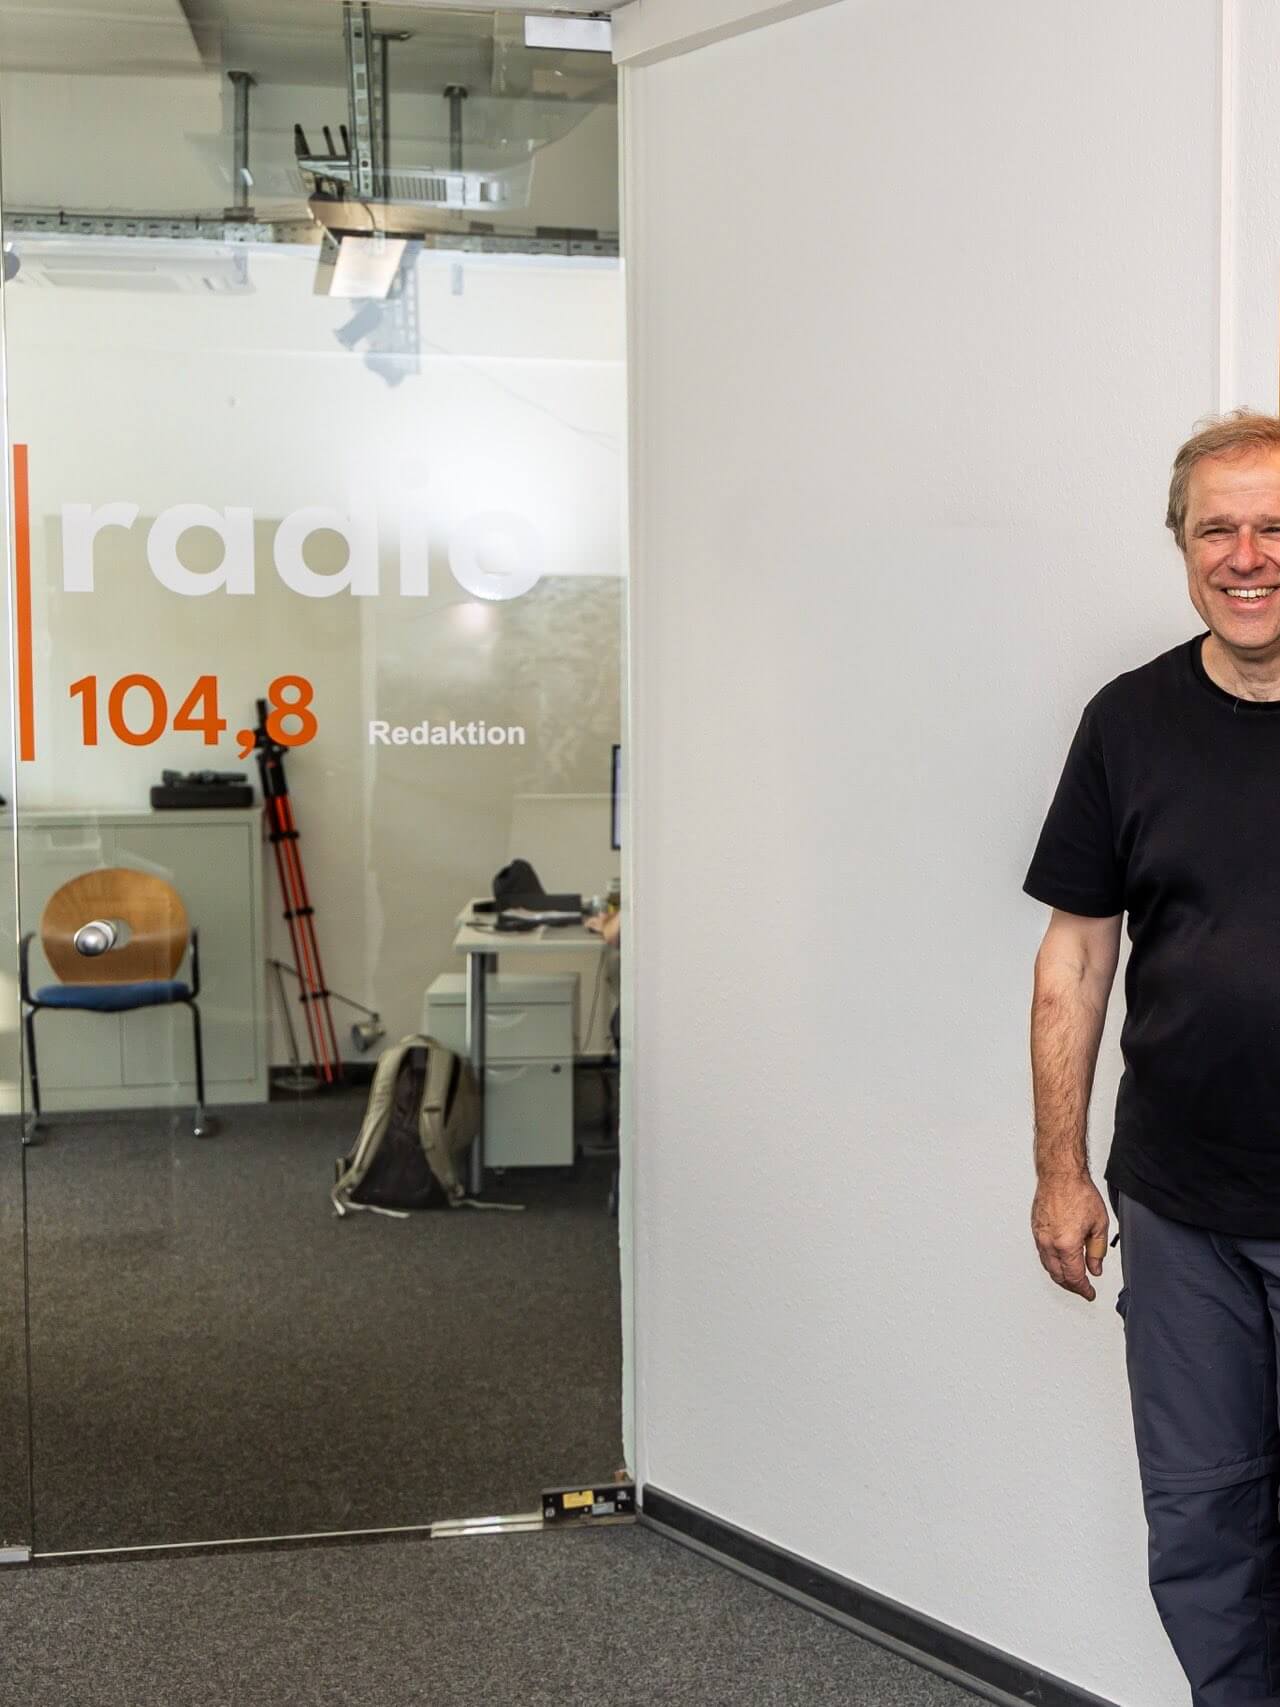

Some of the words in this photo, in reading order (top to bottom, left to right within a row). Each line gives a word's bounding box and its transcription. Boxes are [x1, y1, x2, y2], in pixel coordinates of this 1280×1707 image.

[60, 455, 545, 601] radio
[69, 674, 318, 760] 104,8
[368, 720, 526, 746] Redaktion
